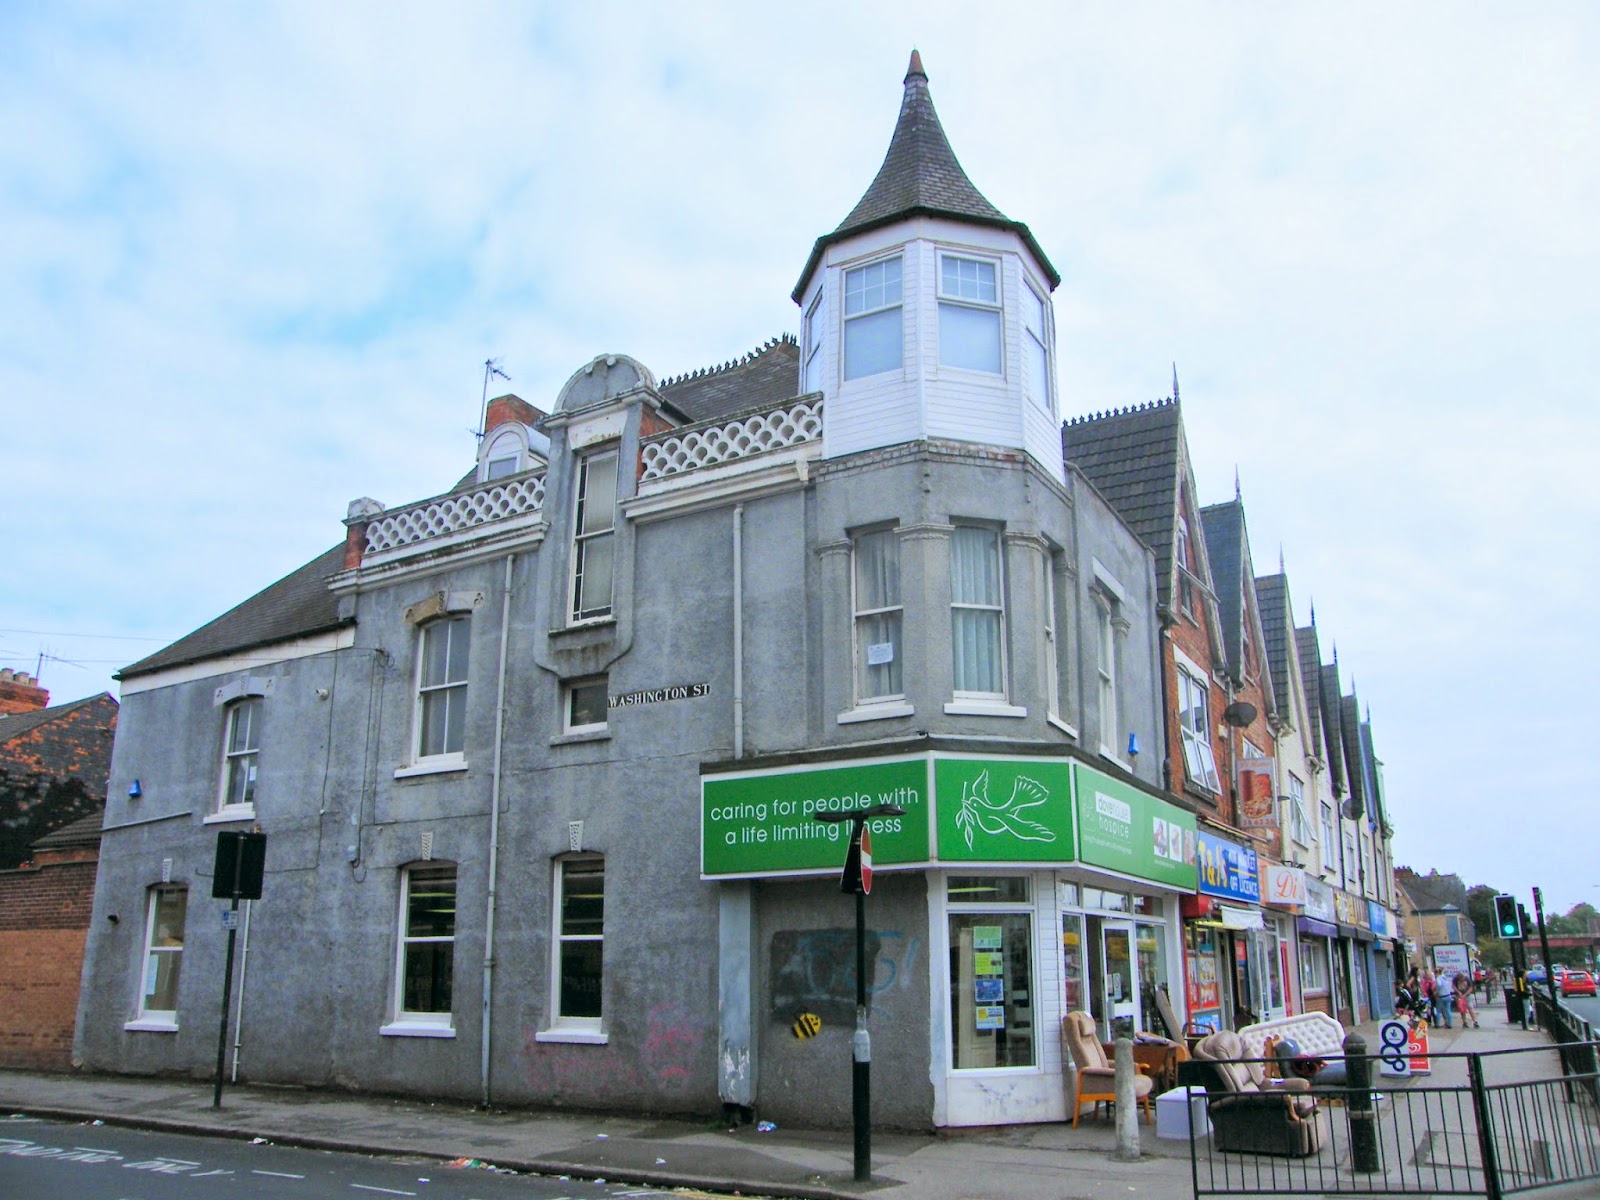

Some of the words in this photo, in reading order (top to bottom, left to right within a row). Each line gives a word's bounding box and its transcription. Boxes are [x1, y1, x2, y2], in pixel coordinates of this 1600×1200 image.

[608, 687, 687, 708] WASHINGTON
[693, 683, 710, 696] ST
[710, 803, 767, 821] caring
[773, 800, 797, 815] for
[803, 792, 871, 816] people
[878, 787, 918, 805] with
[725, 831, 736, 844] a
[742, 826, 768, 843] life
[773, 821, 840, 842] limiting
[1098, 814, 1129, 838] hospice
